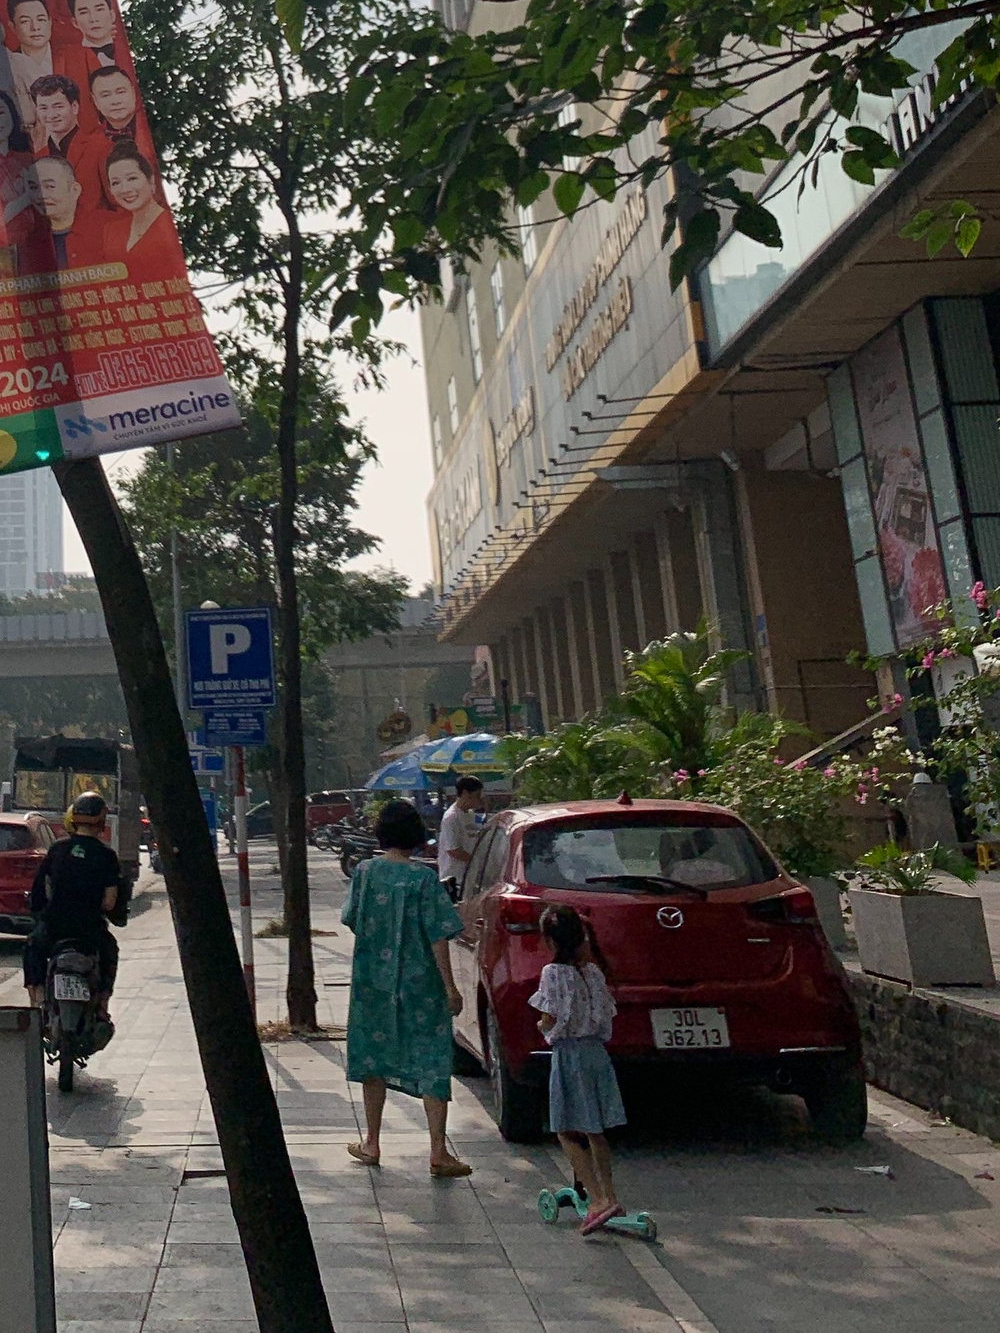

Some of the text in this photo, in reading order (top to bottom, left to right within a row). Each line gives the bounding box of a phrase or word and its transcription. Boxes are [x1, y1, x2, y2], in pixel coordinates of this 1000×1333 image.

[49, 270, 88, 285] THANH
[109, 391, 230, 430] meracine
[209, 624, 251, 675] P
[672, 1010, 705, 1027] 30L
[663, 1029, 722, 1047] 362.13
